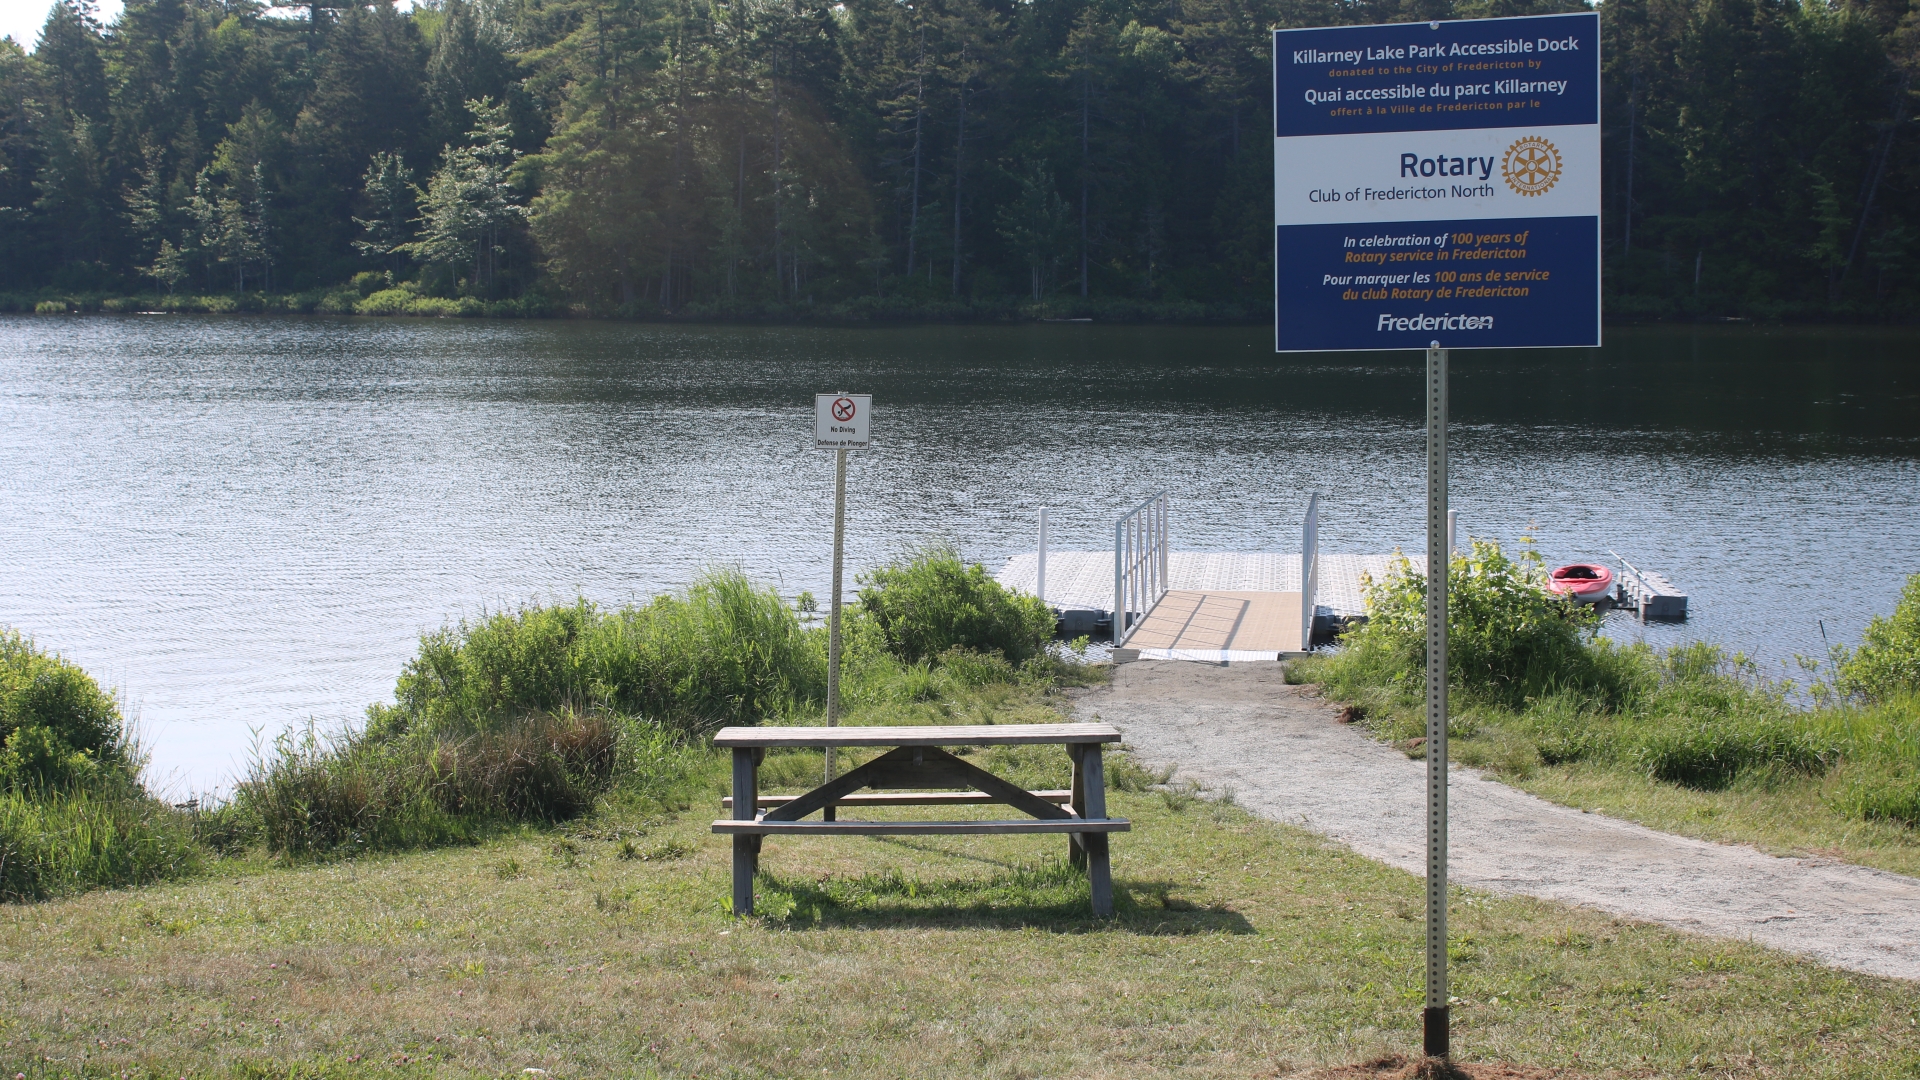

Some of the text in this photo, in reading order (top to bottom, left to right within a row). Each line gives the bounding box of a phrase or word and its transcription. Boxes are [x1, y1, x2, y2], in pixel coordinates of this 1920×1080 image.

[1293, 36, 1579, 65] Killarney Lake Park Accessible Dock
[1329, 58, 1542, 77] donated to the City of Fredericton by
[1304, 78, 1567, 105] Quai accessible du parc Killarney
[1330, 99, 1540, 117] offert à la Ville de Fredericton par le
[1400, 152, 1495, 180] Rotary
[1511, 175, 1554, 190] INTERNATIONAL
[1309, 183, 1494, 203] Club of Fredericton North
[1344, 230, 1529, 248] In celebration of 100 years of
[1345, 247, 1526, 265] Rotary service in Fredericton
[1323, 269, 1550, 288] Pour marquer les 100 ans de service
[1342, 286, 1529, 301] du club Rotary de Fredericton
[1377, 313, 1493, 331] Fredericton
[839, 426, 855, 434] Diving
